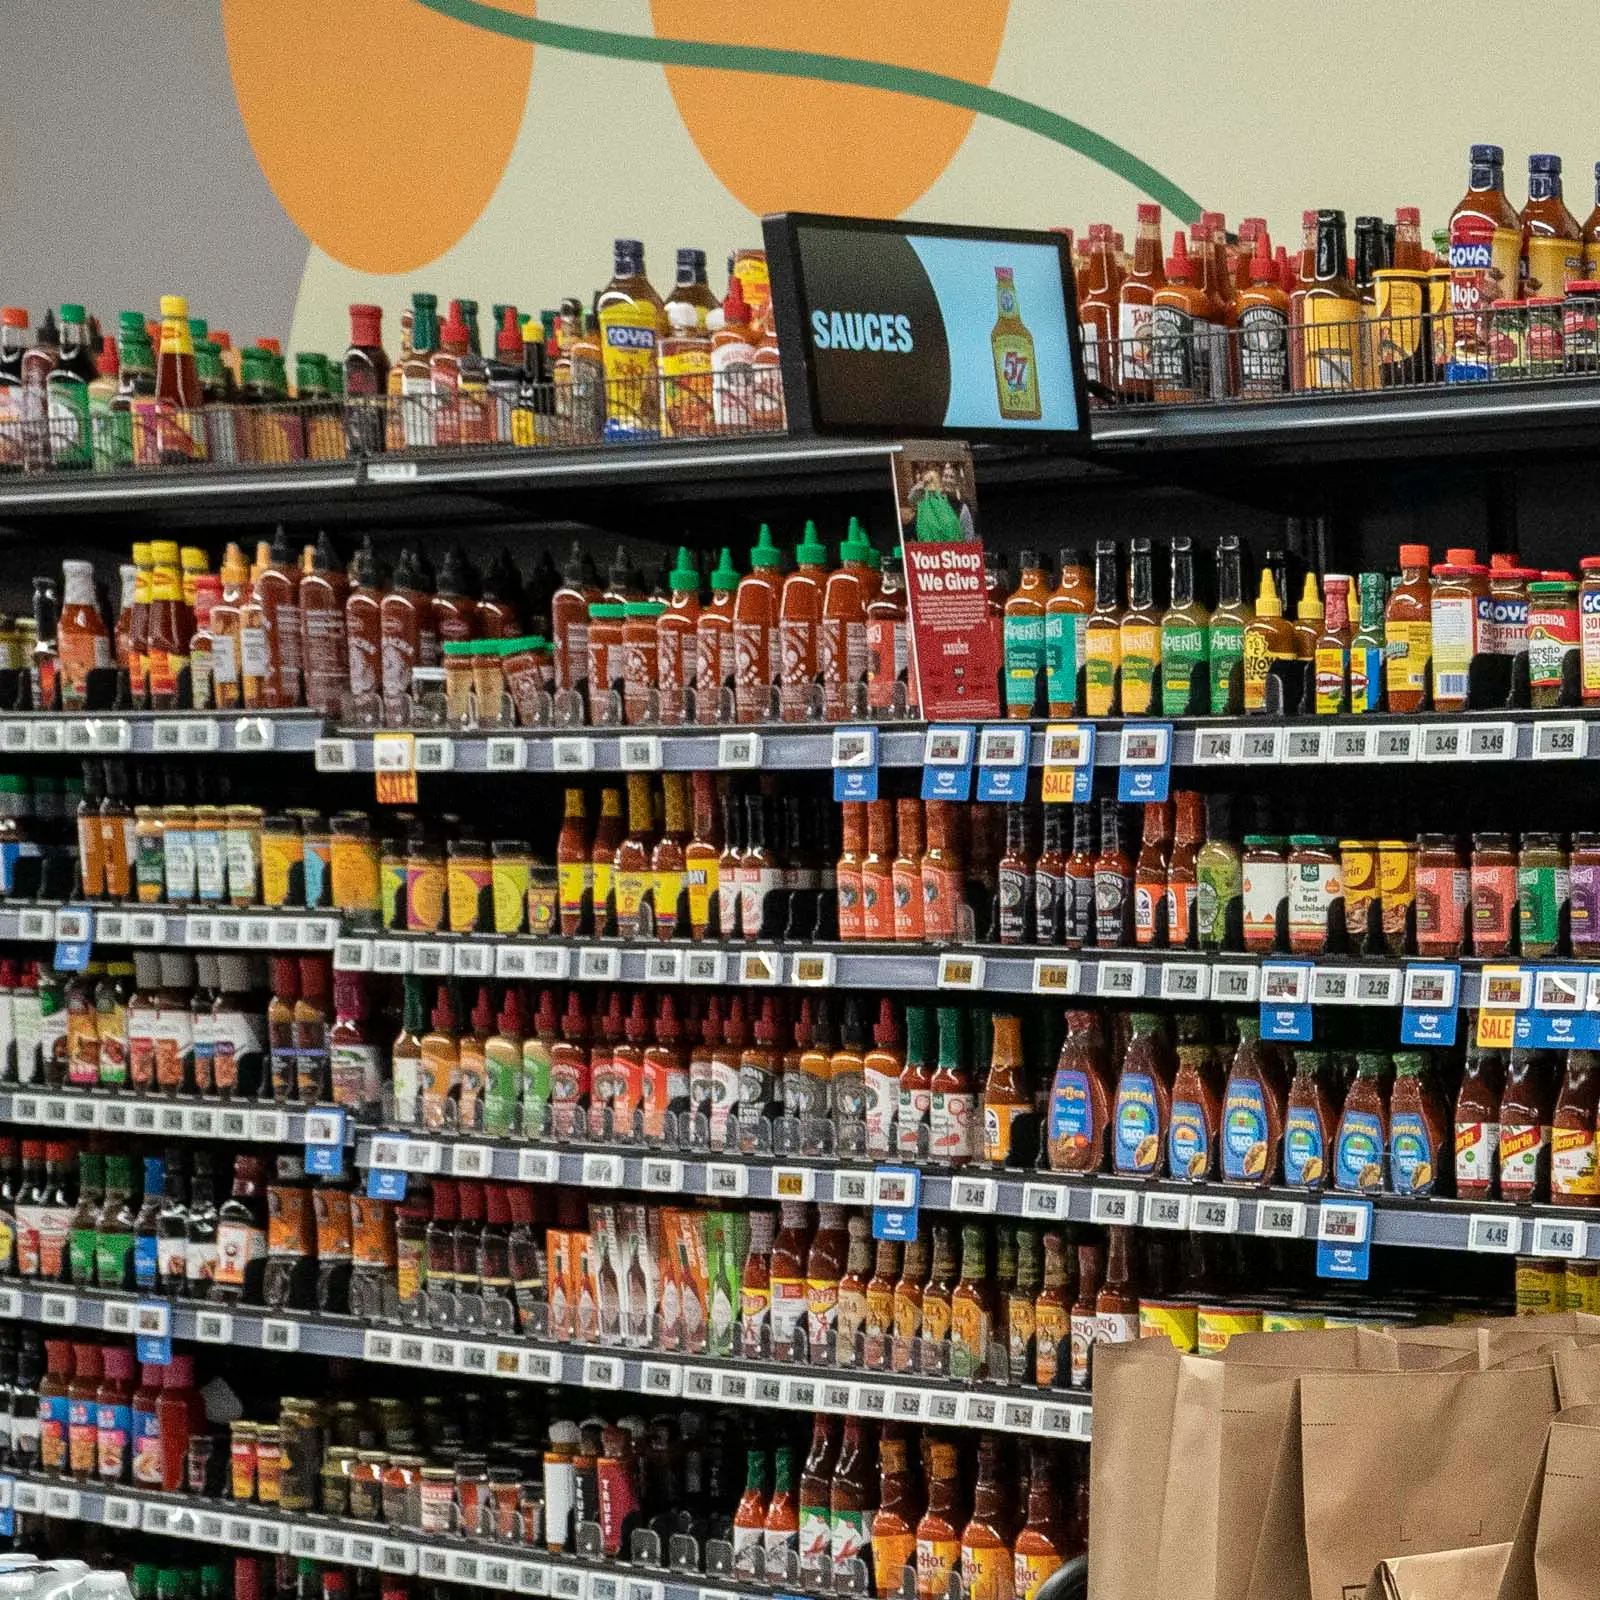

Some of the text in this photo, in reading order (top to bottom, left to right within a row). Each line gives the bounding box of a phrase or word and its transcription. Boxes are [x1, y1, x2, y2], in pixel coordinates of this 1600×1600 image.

[1449, 243, 1492, 268] GOYA
[811, 310, 914, 354] SAUCES
[1003, 350, 1028, 393] 57
[911, 550, 981, 574] You Shop
[918, 572, 979, 592] We Give
[1252, 737, 1274, 755] 7.49
[1300, 737, 1320, 754] 3.19
[1435, 734, 1457, 751] 3.49
[1551, 732, 1574, 748] 5.29
[1044, 774, 1072, 794] SALE
[1550, 1231, 1573, 1249] 4.49
